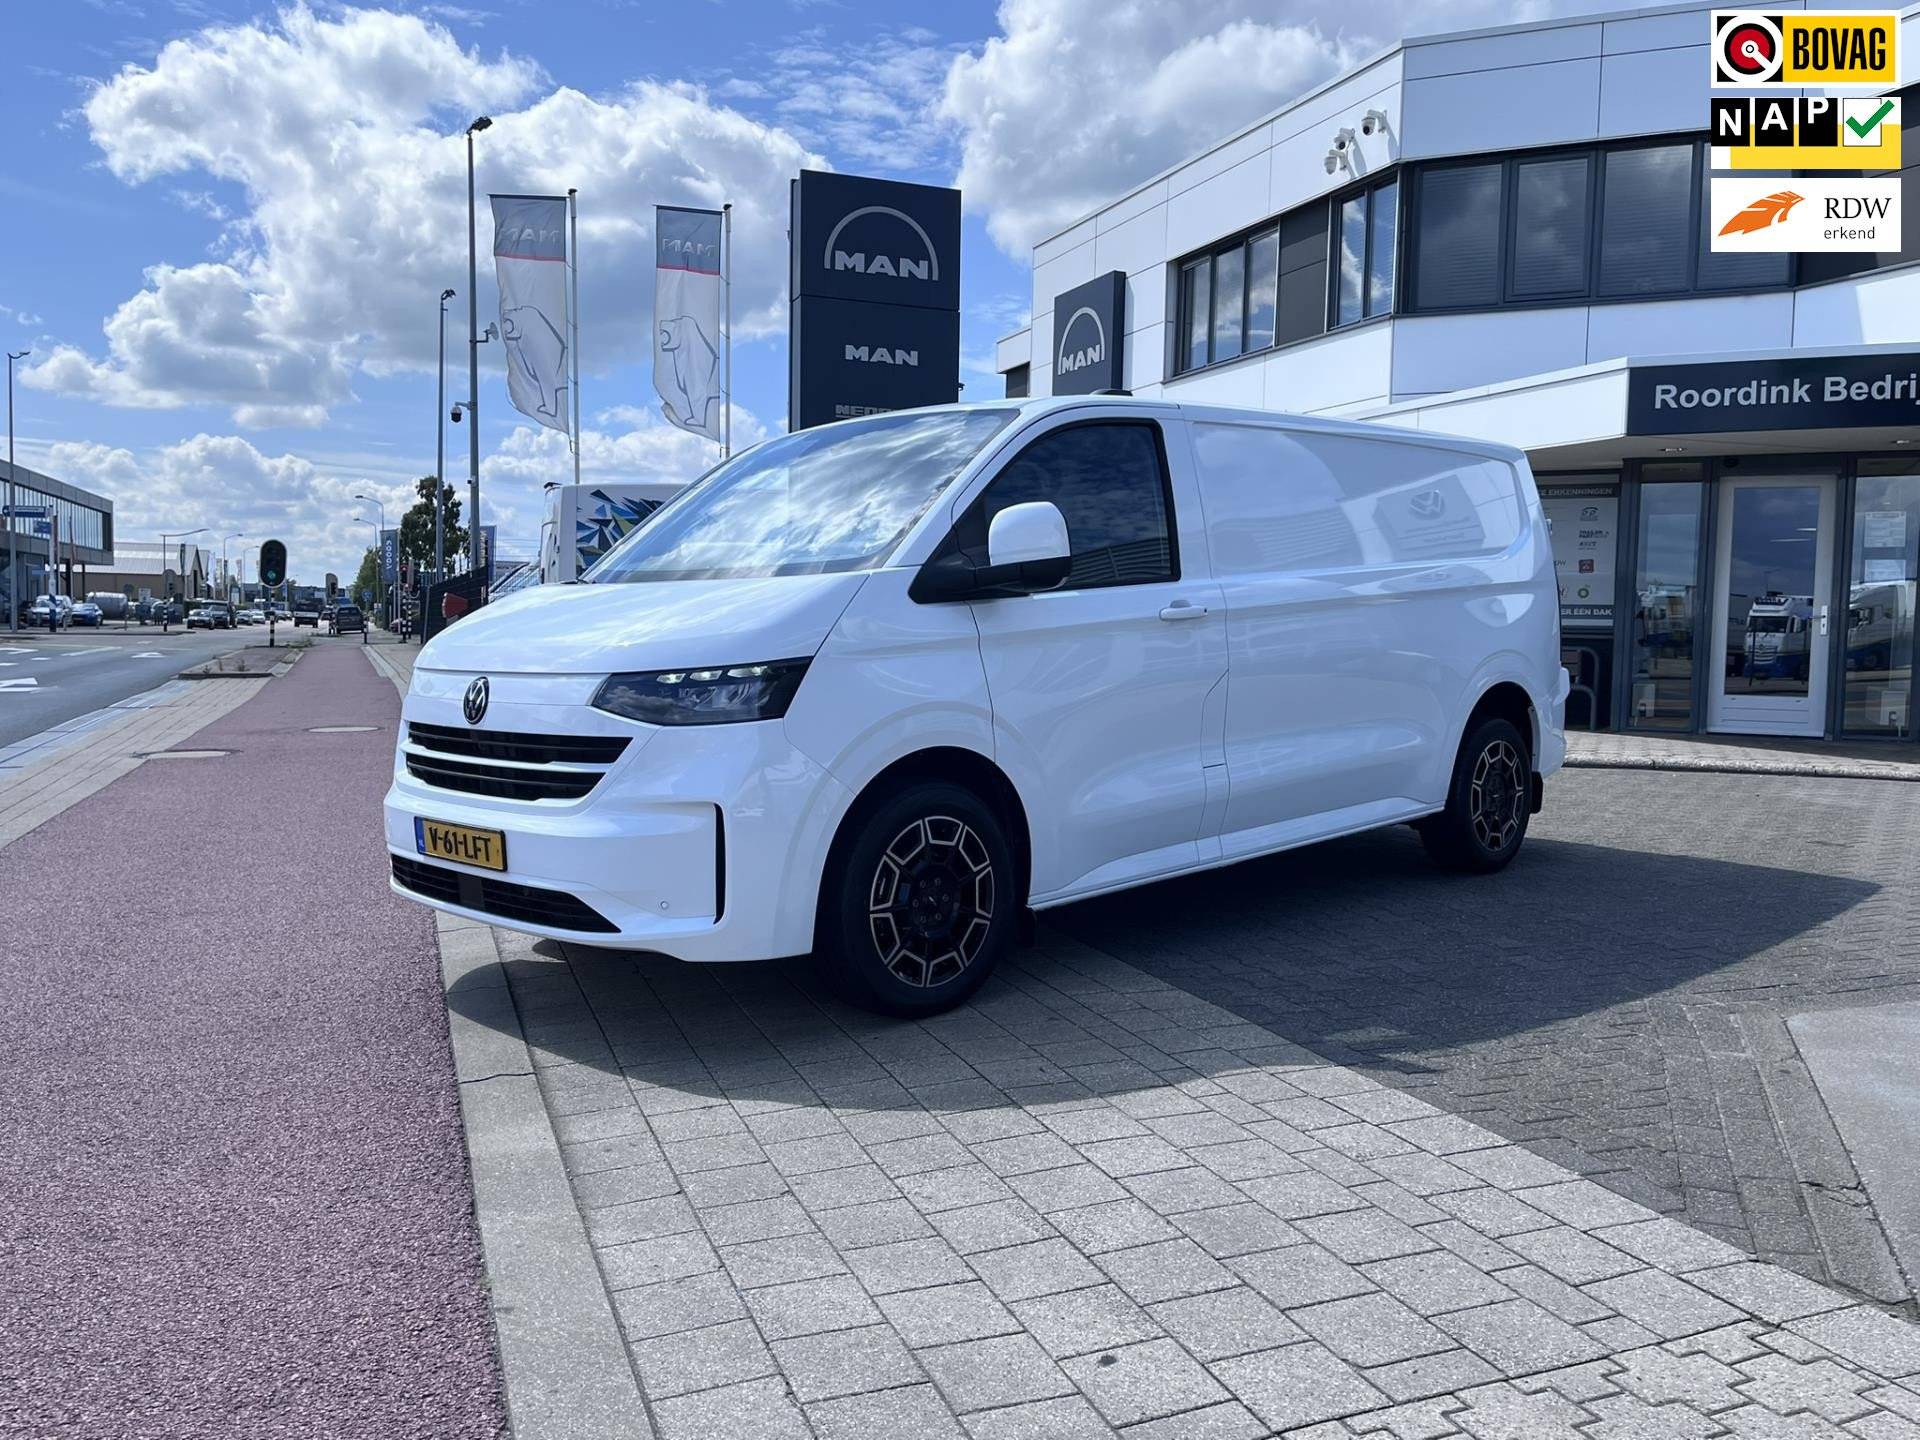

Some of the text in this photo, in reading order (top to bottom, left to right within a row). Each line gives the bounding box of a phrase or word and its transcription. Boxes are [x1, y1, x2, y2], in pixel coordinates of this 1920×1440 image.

[834, 250, 928, 280] MAN
[845, 344, 918, 366] MAN
[1062, 344, 1100, 374] MAN
[1654, 373, 1920, 409] Roordink Bedri
[1593, 608, 1612, 616] DAK
[428, 826, 491, 862] V-61-LFT
